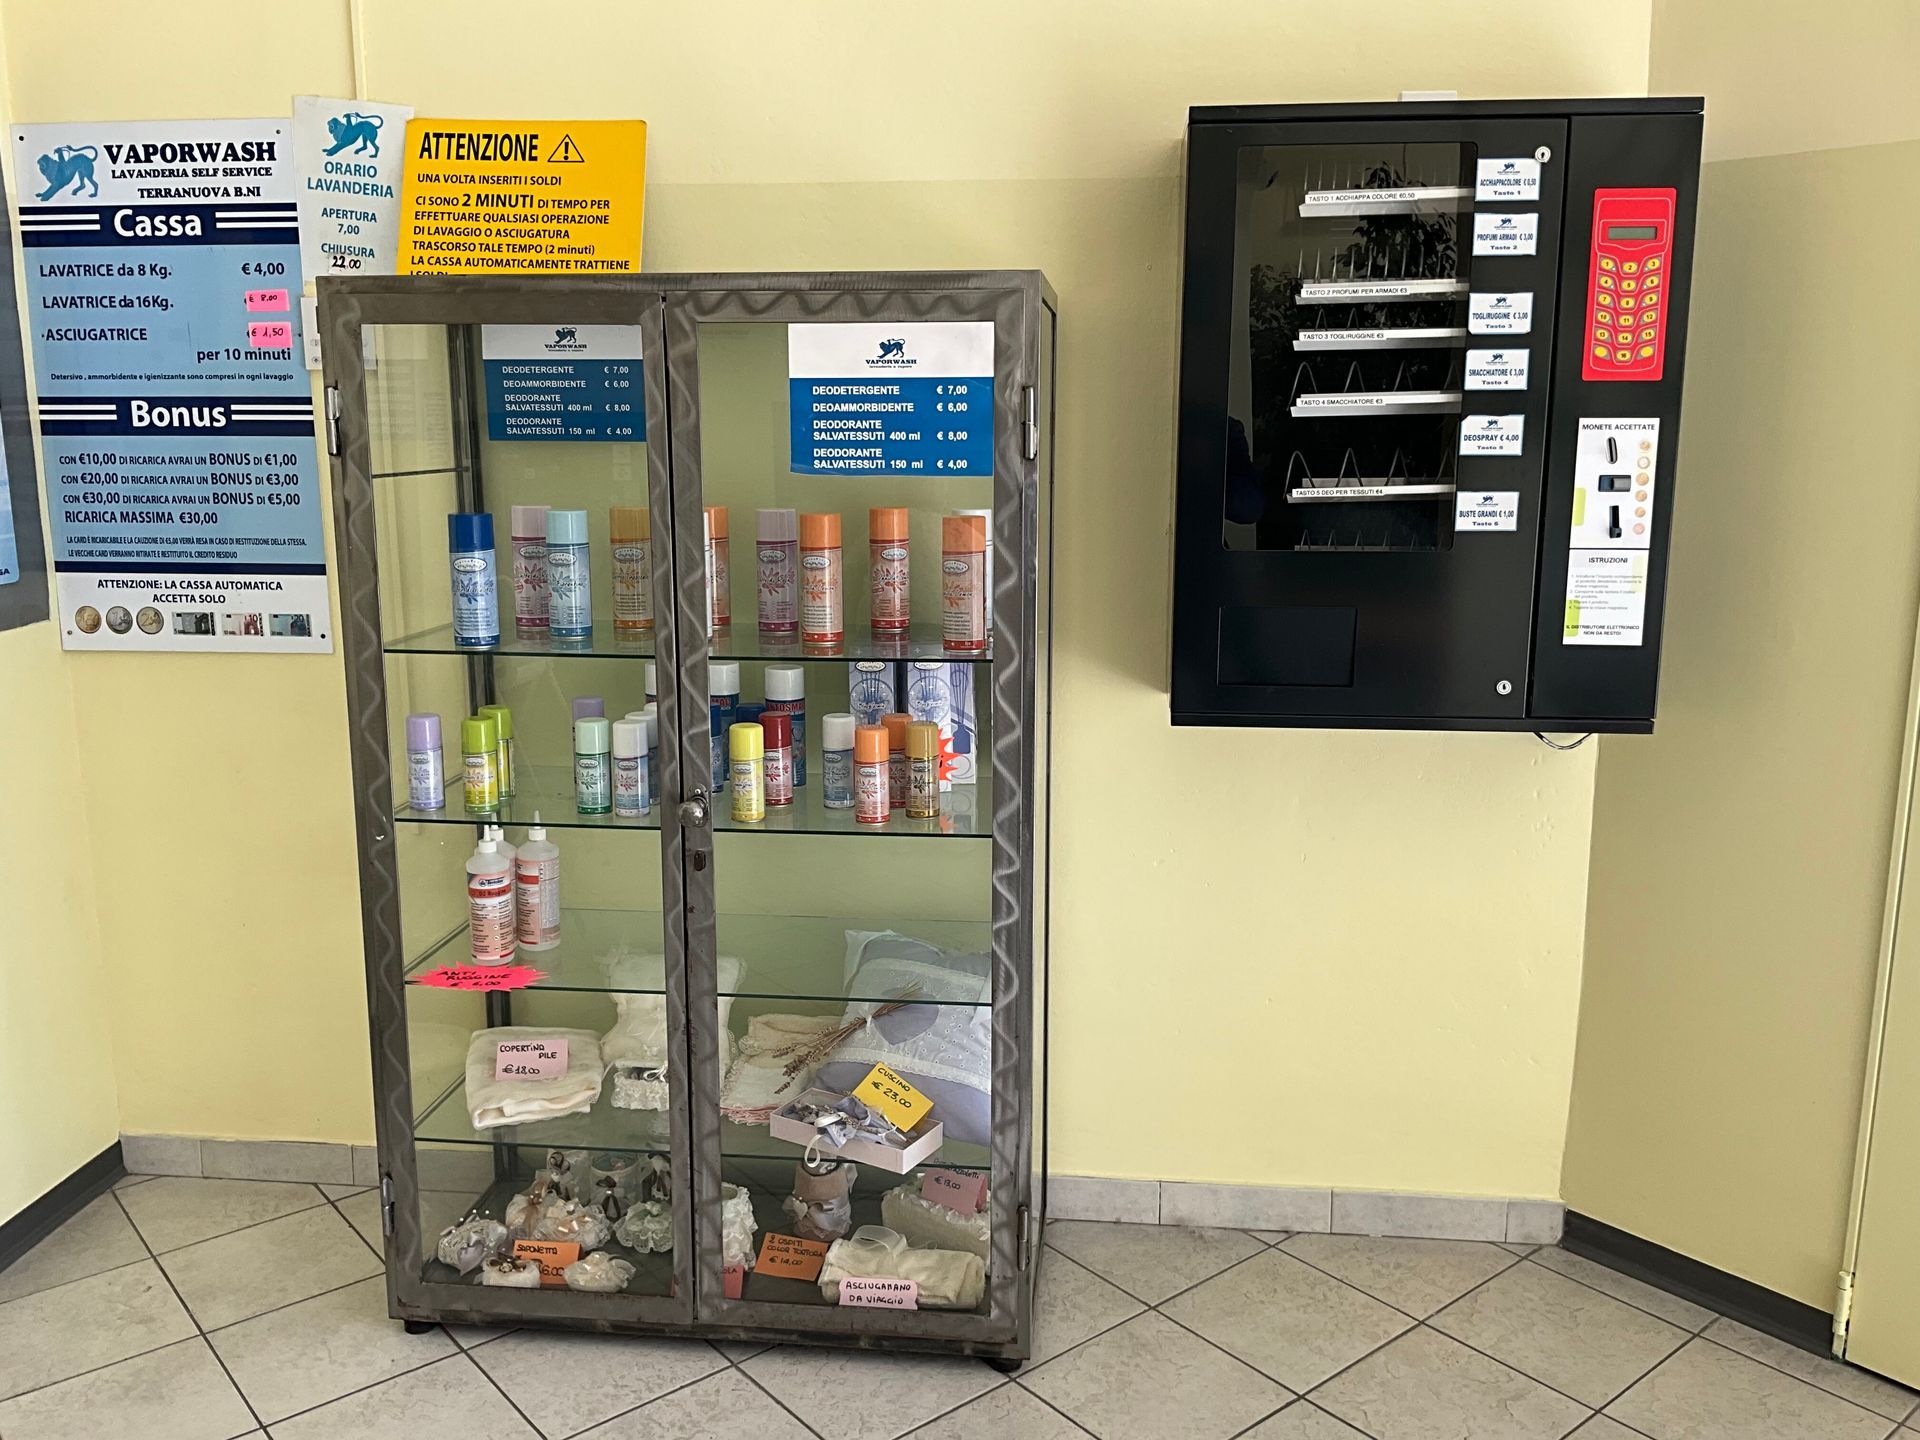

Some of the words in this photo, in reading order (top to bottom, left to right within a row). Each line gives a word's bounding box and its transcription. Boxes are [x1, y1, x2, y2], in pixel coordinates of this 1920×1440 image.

[103, 141, 277, 165] VAPORWASH
[419, 132, 539, 161] ATTENZIONE
[111, 168, 189, 179] LAVANDERIA
[192, 168, 219, 178] SELF
[222, 166, 272, 177] SERVICE
[324, 161, 377, 178] ORARIO
[417, 173, 440, 184] UNA
[442, 174, 476, 185] VOLTA
[478, 174, 522, 185] INSERITI
[524, 175, 528, 185] I
[530, 175, 562, 186] SOLDI
[138, 187, 230, 198] TERRANUOVA
[234, 186, 261, 197] B.NI
[307, 177, 394, 199] LAVANDERIA
[416, 195, 426, 206] CI
[428, 196, 459, 207] SONO
[462, 194, 472, 207] 2
[475, 194, 534, 208] MINUTI
[538, 198, 548, 208] DI
[551, 198, 588, 210] TEMPO
[590, 199, 610, 210] PER
[321, 207, 377, 224] APERTURA
[414, 210, 480, 223] EFFETTUARE
[482, 212, 539, 225] QUALSIASI
[542, 213, 609, 225] OPERAZIONE
[113, 208, 202, 237] Cassa
[337, 224, 360, 236] 7,00
[413, 225, 425, 236] DI
[426, 226, 482, 238] LAVAGGIO
[484, 227, 493, 237] O
[495, 227, 570, 239] ASCIUGATURA
[321, 243, 375, 259] CHIUSURA
[413, 240, 476, 252] TRASCORSO
[478, 242, 504, 253] TALE
[506, 242, 543, 254] TEMPO
[545, 243, 554, 256] (2
[557, 244, 595, 256] minuti)
[411, 255, 425, 266] LA
[427, 256, 462, 267] CASSA
[464, 257, 570, 270] AUTOMATICAMENTE
[572, 259, 629, 270] TRATTIENE
[39, 264, 114, 277] LAVATRICE
[117, 263, 134, 276] da
[138, 264, 146, 275] 8
[150, 263, 172, 278] Kg.
[241, 263, 250, 275] €
[254, 263, 285, 278] 4,00
[42, 296, 116, 308] LAVATRICE
[118, 296, 135, 308] da
[136, 296, 150, 307] 16
[151, 296, 174, 310] Kg.
[46, 328, 147, 341] ASCIUGATRICE
[251, 328, 257, 337] €
[262, 327, 284, 339] 1,50
[197, 350, 220, 362] per
[224, 349, 241, 360] 10
[244, 349, 291, 360] minuti
[144, 373, 185, 382] igienizzante
[205, 373, 236, 382] compresi
[246, 373, 261, 382] ogni
[263, 373, 293, 381] lavaggio
[813, 386, 899, 395] DEODETERGENTE
[937, 386, 943, 394] €
[948, 386, 967, 395] 7,00
[130, 400, 226, 427] Bonus
[813, 403, 914, 412] DEOAMMORBIDENTE
[937, 403, 943, 411] €
[948, 402, 967, 412] 6,00
[813, 420, 882, 429] DEODORANTE
[813, 432, 885, 440] SALVATESSUTI
[890, 432, 906, 440] 400
[909, 432, 920, 440] ml
[937, 432, 943, 440] €
[948, 432, 967, 441] 8,00
[814, 448, 882, 457] DEODORANTE
[59, 455, 76, 465] CON
[79, 453, 116, 466] €10,00
[119, 455, 128, 465] DI
[130, 455, 166, 465] RICARICA
[168, 456, 193, 465] AVRAI
[195, 456, 207, 465] UN
[209, 453, 250, 466] BONUS
[253, 456, 262, 465] DI
[264, 453, 297, 466] €1,00
[814, 460, 885, 469] SALVATESSUTI
[890, 460, 906, 468] 150
[912, 460, 923, 468] ml
[937, 460, 943, 468] €
[948, 460, 967, 470] 4,00
[65, 511, 117, 523] RICARICA
[120, 512, 174, 524] MASSIMA
[180, 512, 218, 526] €30,00
[97, 579, 162, 590] ATTENZIONE:
[164, 580, 176, 590] LA
[180, 580, 212, 590] CASSA
[215, 580, 283, 591] AUTOMATICA
[152, 594, 197, 603] ACCETTA
[199, 594, 226, 603] SOLO
[500, 1043, 544, 1052] COPERTINA
[877, 1067, 911, 1092] CUSCINO
[871, 1080, 882, 1090] €
[883, 1088, 911, 1109] 23,00
[846, 1281, 911, 1291] ASCIUGAMANO
[849, 1294, 862, 1303] DA
[866, 1293, 903, 1305] VIAGGIO
